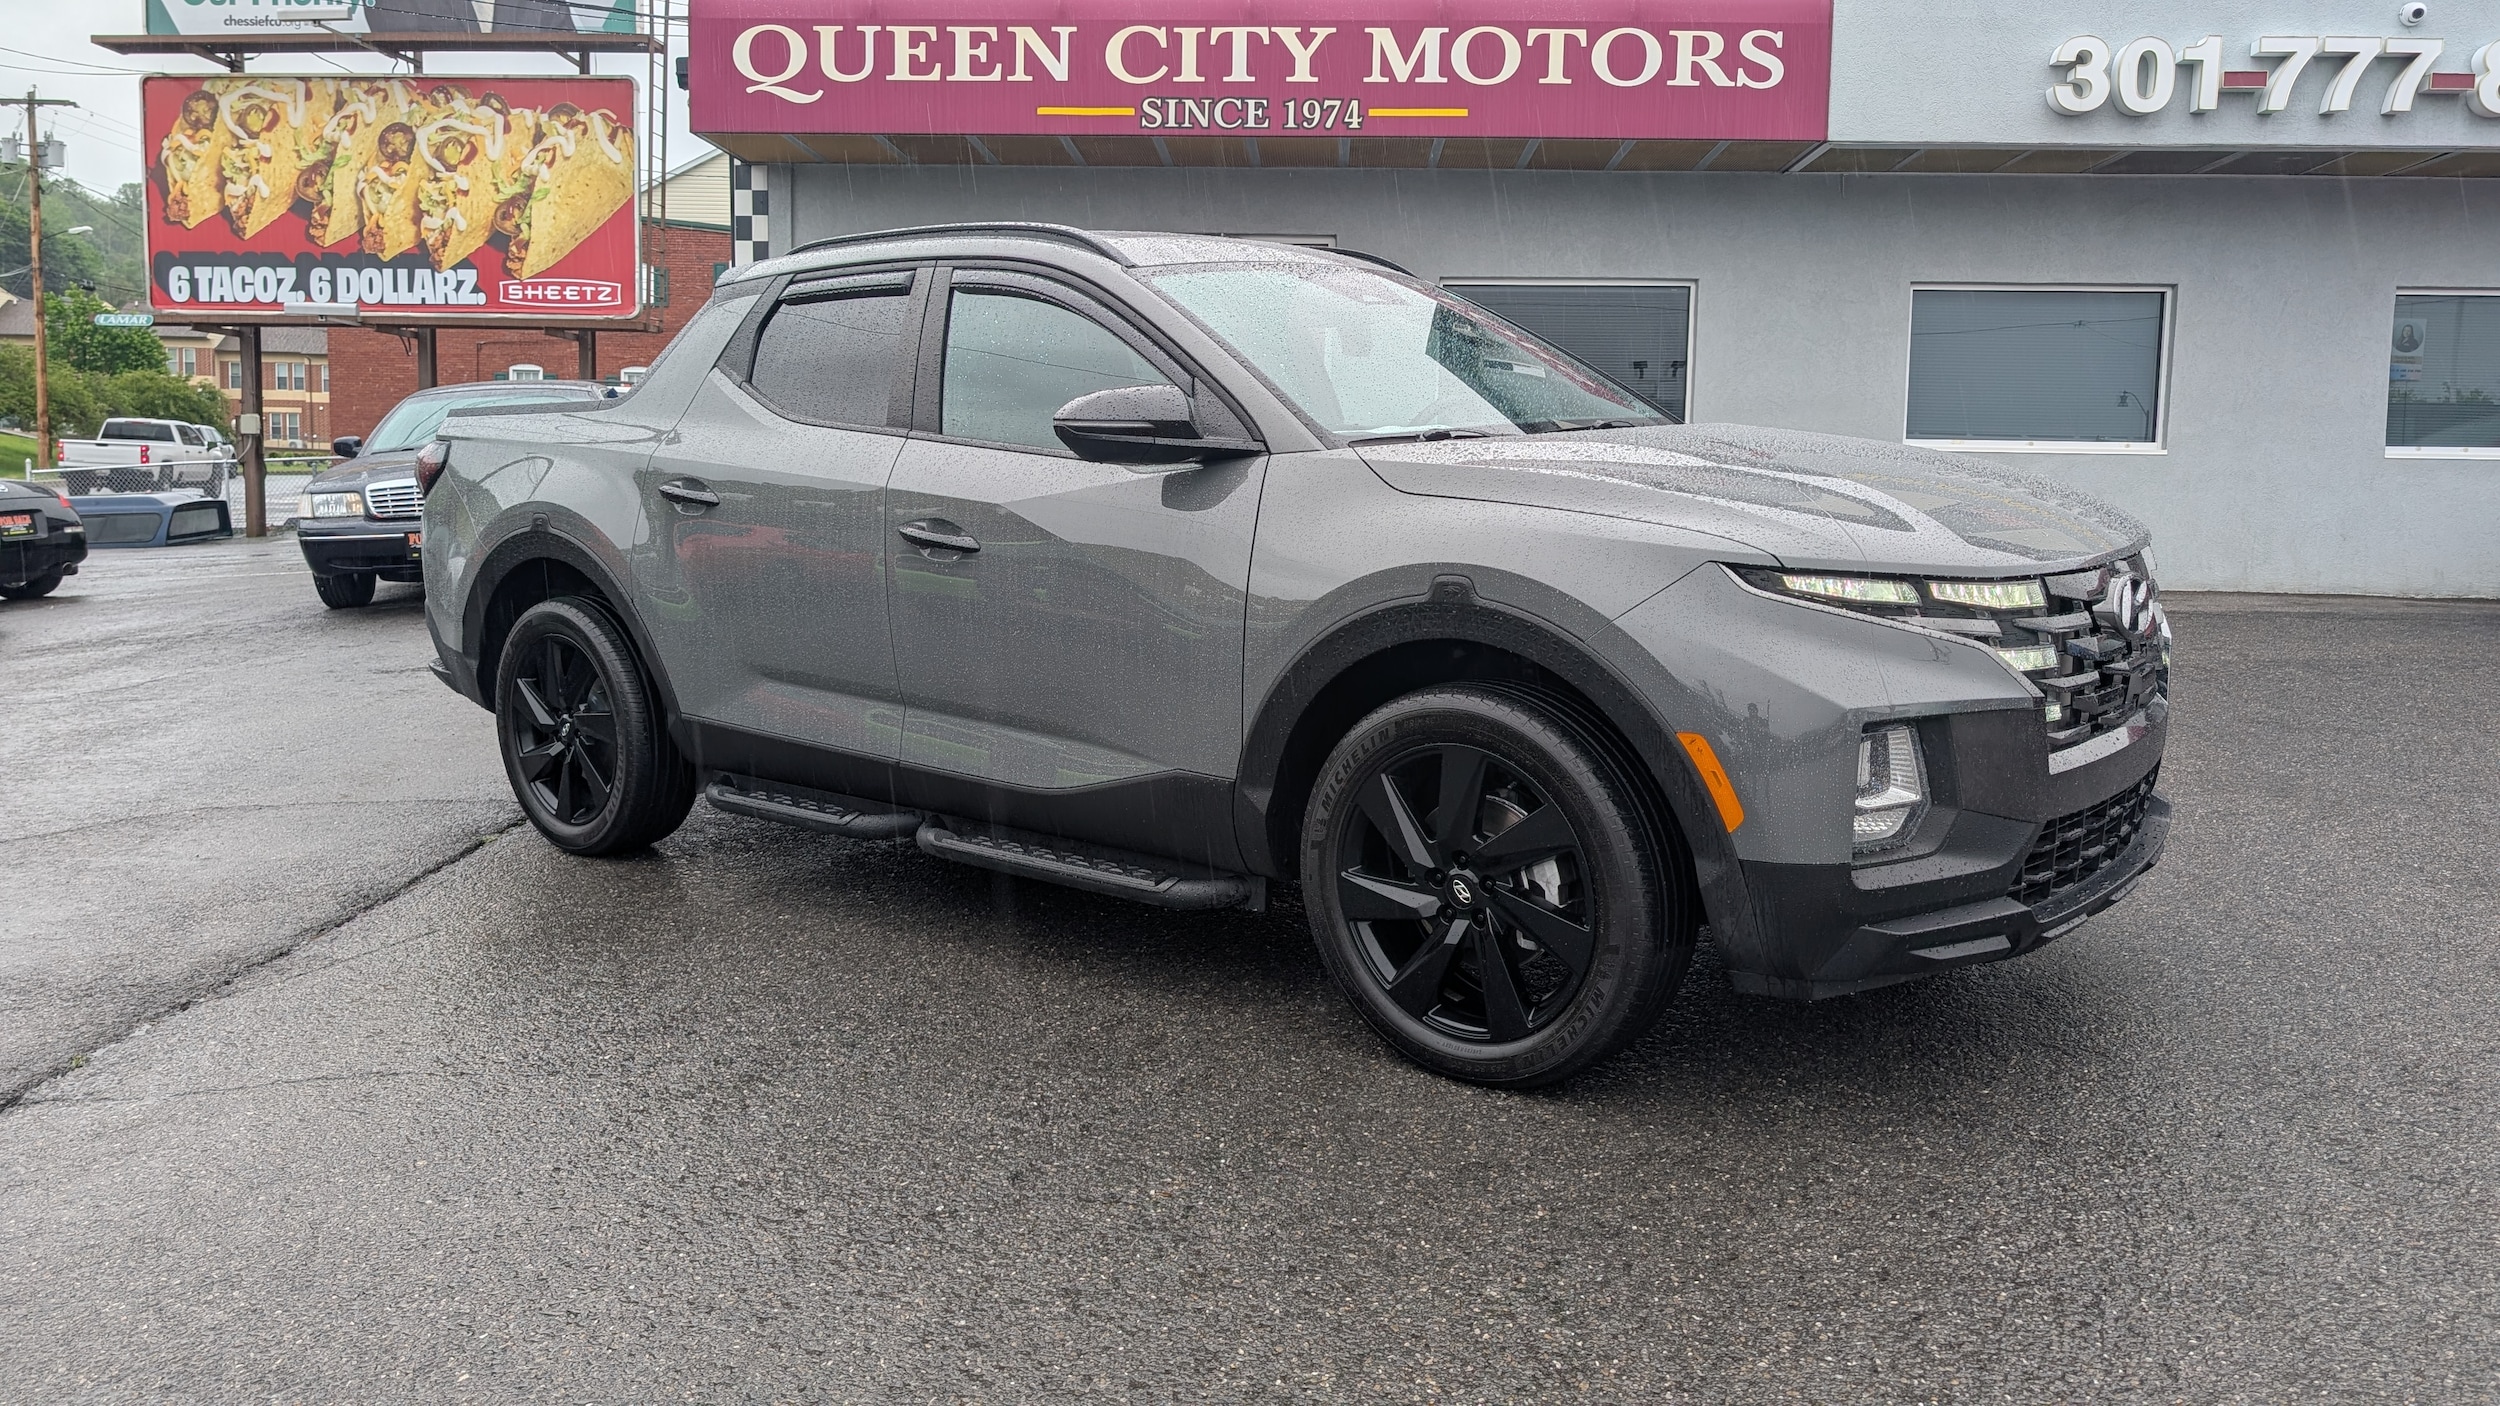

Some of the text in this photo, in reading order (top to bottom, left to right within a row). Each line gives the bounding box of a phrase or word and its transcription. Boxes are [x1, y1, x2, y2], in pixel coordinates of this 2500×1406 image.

[732, 25, 1785, 104] QUEEN CITY MOTORS
[1141, 97, 1363, 129] SINCE 1974
[168, 266, 191, 303] 6
[309, 267, 332, 303] 6
[336, 267, 487, 305] DOLLARZ.
[508, 285, 613, 301] SHEETZ
[100, 315, 148, 325] LAMAR
[1321, 727, 1390, 813] MICHELIN
[1522, 985, 1606, 1066] MICHELIN
